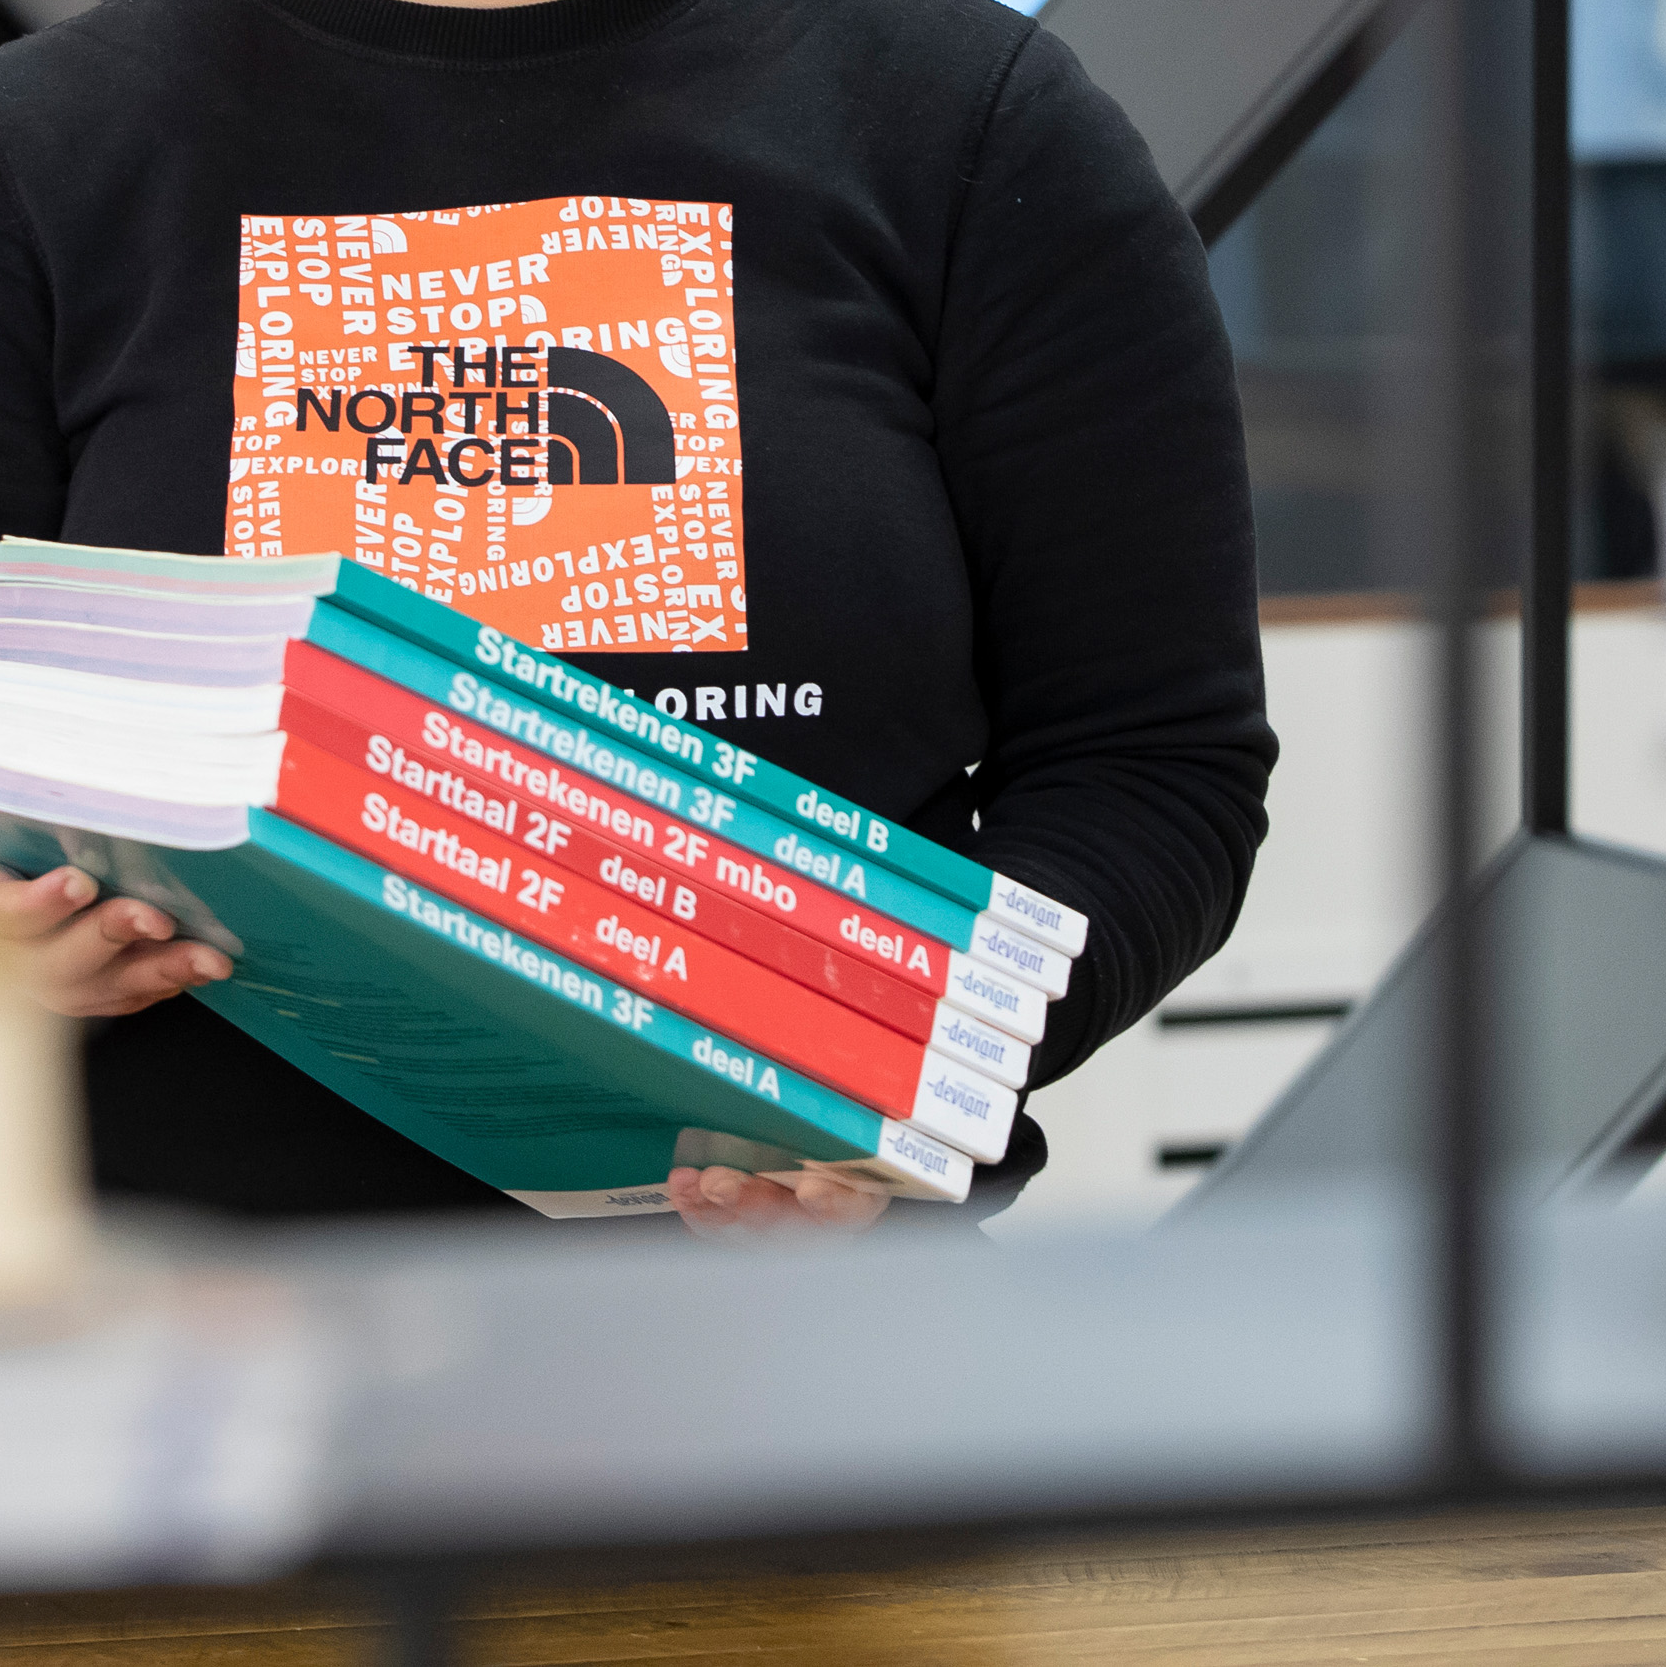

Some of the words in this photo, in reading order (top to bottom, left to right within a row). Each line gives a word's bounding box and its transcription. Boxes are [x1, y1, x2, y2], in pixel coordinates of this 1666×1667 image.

[541, 224, 658, 255] NEVER
[559, 196, 651, 222] STOP
[293, 218, 333, 307] STOP
[334, 217, 377, 335] NEVER
[381, 253, 550, 300] NEVER
[250, 217, 299, 428] EXPLORING
[386, 297, 517, 335] STOP
[676, 203, 738, 429] EXPLORING
[299, 346, 378, 365] NEVER
[301, 366, 362, 383] STOP
[407, 346, 539, 388] THE
[296, 388, 539, 434] NORTH
[302, 381, 439, 400] XPLORING
[366, 437, 539, 487] FACE
[355, 479, 388, 576] EVER
[679, 484, 708, 560] STOP
[706, 481, 738, 580] NEVER
[458, 534, 655, 596] EXPLORING
[561, 573, 660, 613] STOP
[541, 610, 669, 649] NEVER
[623, 683, 823, 720] ORING
[475, 624, 704, 765] Startrekenen
[711, 742, 757, 785] 3F
[796, 790, 861, 840] deel
[866, 818, 889, 853] B
[449, 672, 681, 809] Startrekenen
[688, 786, 737, 830] 3F
[774, 833, 840, 884] deel
[842, 864, 867, 899] A
[366, 733, 518, 835] Starttaal
[523, 811, 572, 856] 2F
[599, 855, 666, 907] deel
[672, 885, 698, 922] B
[422, 711, 655, 847] Startrekenen
[663, 825, 709, 868] 2F
[716, 855, 798, 912] mbo
[839, 914, 904, 964] deel
[907, 944, 931, 978] A
[361, 792, 511, 894] Starttaal
[517, 868, 566, 915] 2F
[595, 915, 661, 967] deel
[663, 945, 688, 982] A
[382, 873, 603, 1012] Startrekenen
[611, 988, 655, 1032] 3F
[692, 1036, 755, 1086] deel
[756, 1066, 781, 1102] A
